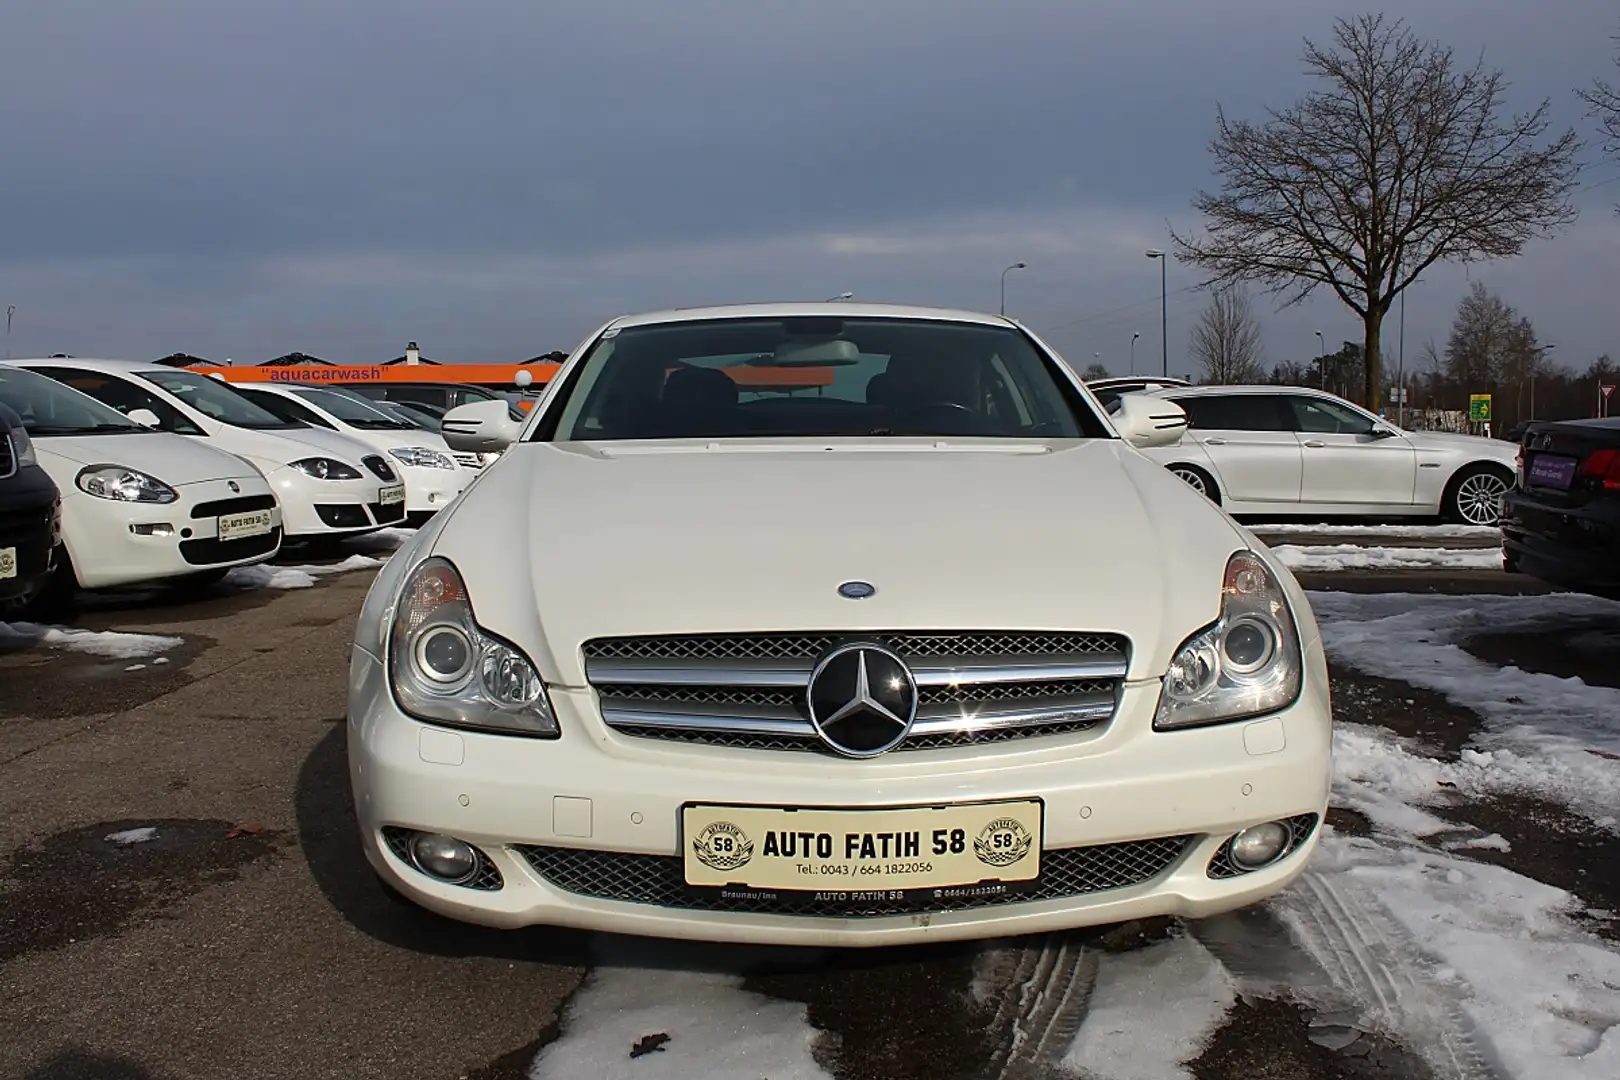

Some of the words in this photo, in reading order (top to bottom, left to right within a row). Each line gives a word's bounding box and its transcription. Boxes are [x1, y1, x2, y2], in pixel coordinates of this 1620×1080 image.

[262, 367, 389, 382] "aquacarwash"
[713, 837, 733, 852] 58
[762, 831, 833, 859] AUTO
[845, 831, 920, 859] FATIH
[931, 828, 966, 855] 58
[993, 833, 1013, 849] 58
[796, 864, 818, 875] Tel.:
[820, 865, 849, 876] 0043
[859, 864, 882, 876] 664
[885, 862, 933, 875] 1822056
[814, 892, 848, 901] AUTO
[851, 891, 886, 901] FATIH
[889, 890, 904, 900] 58
